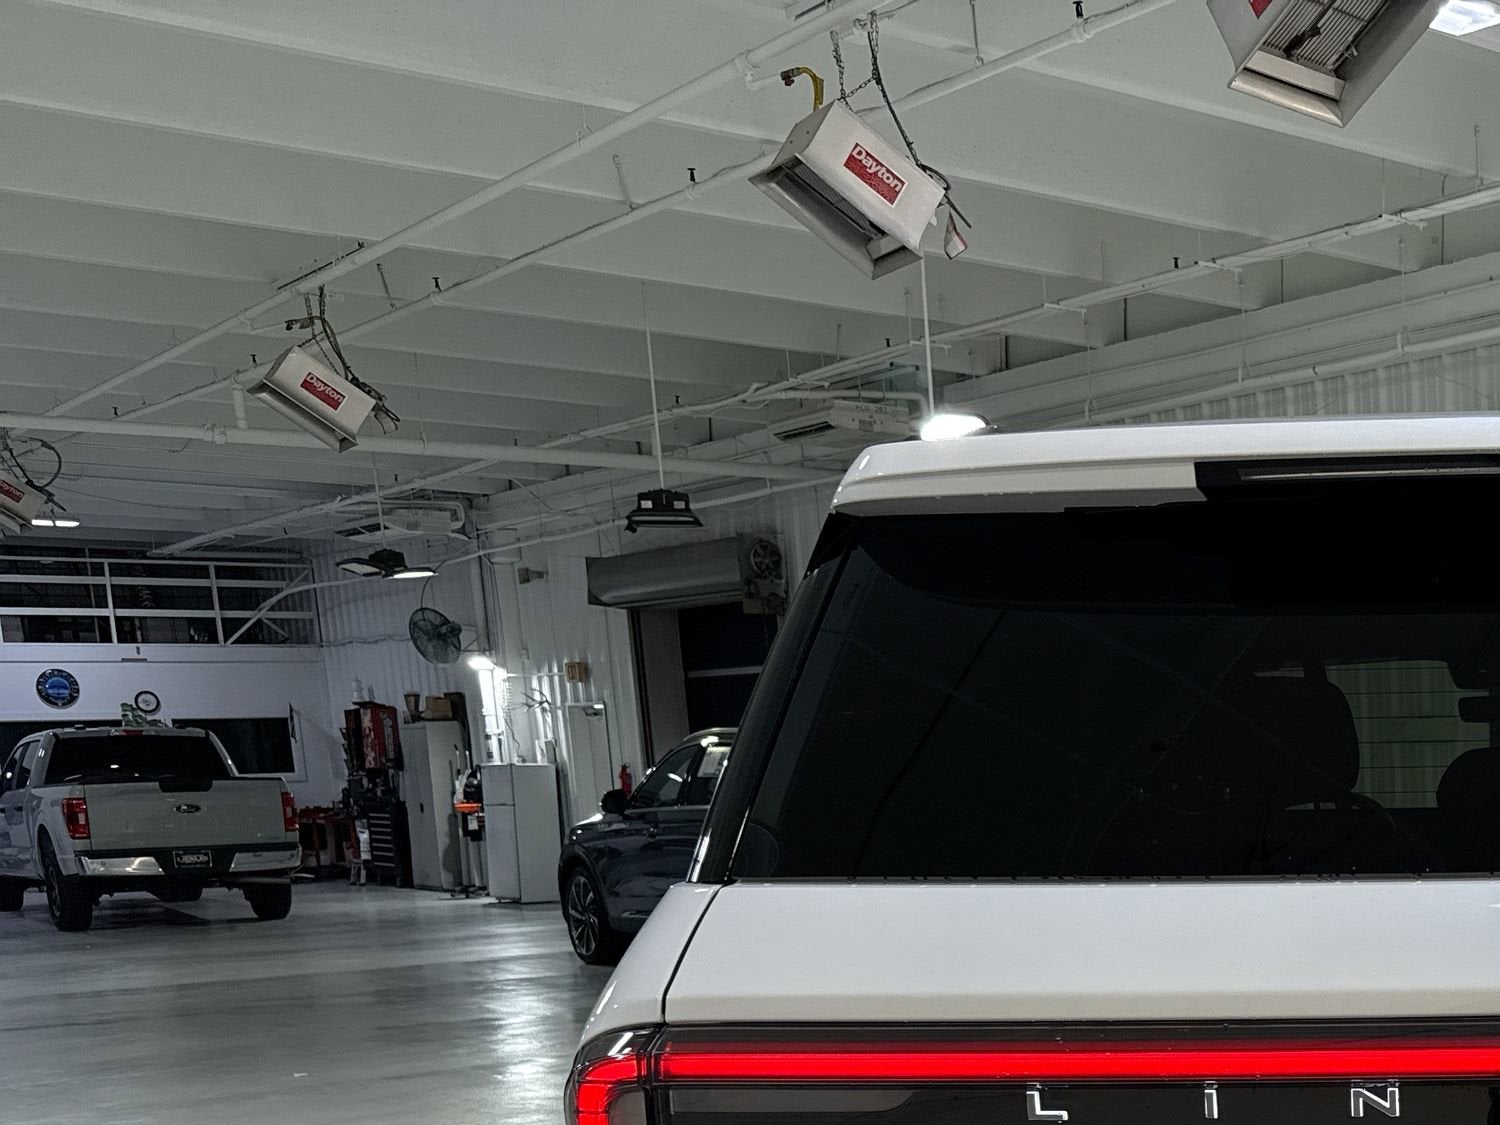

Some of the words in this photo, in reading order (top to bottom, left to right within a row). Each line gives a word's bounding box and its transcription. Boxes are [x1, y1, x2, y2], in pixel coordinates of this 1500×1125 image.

[852, 146, 902, 192] Dayton
[306, 374, 343, 402] Dayton
[0, 480, 23, 498] ayton
